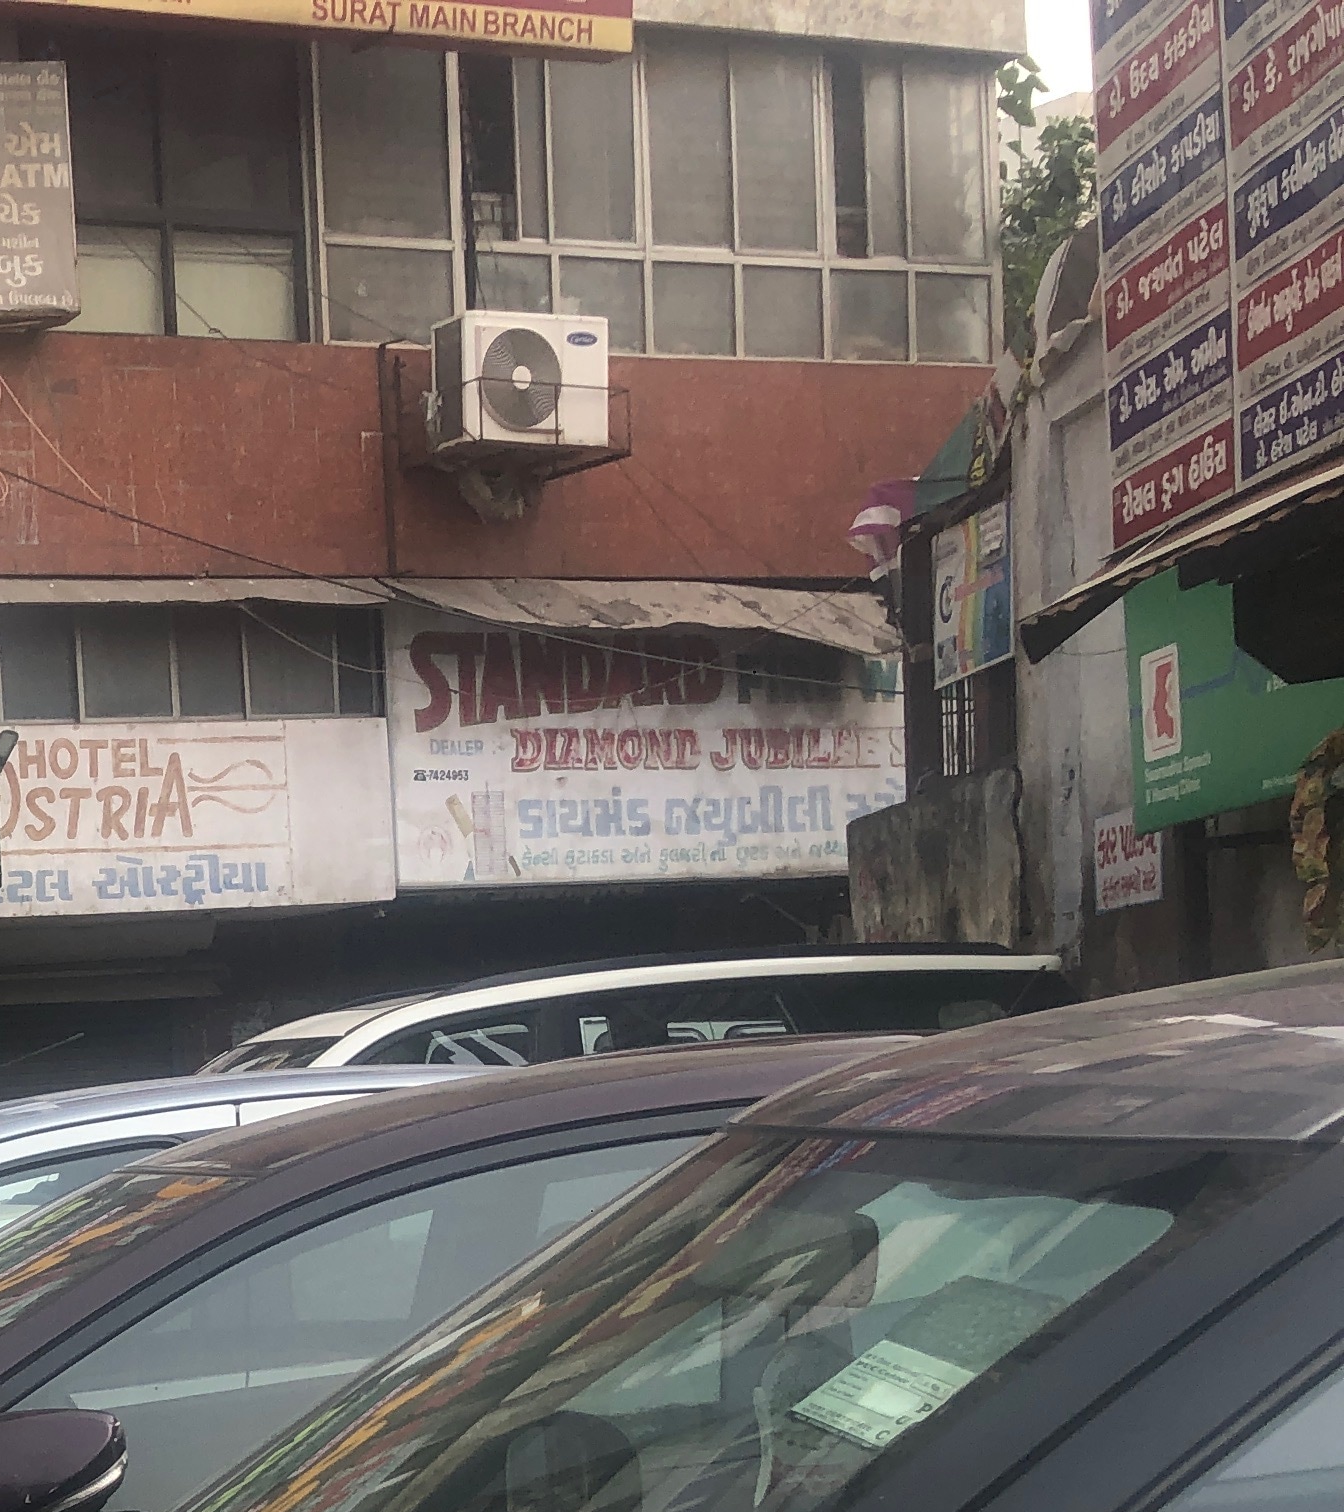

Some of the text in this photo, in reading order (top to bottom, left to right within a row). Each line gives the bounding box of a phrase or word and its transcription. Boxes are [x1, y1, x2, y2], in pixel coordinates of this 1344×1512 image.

[312, 0, 594, 44] SURAT MAIN BRANCH
[0, 162, 70, 189] ATM
[17, 736, 164, 780] HOTEL
[428, 738, 484, 757] DEALER
[509, 727, 701, 773] DIAMOND
[710, 726, 881, 772] JUBILEE
